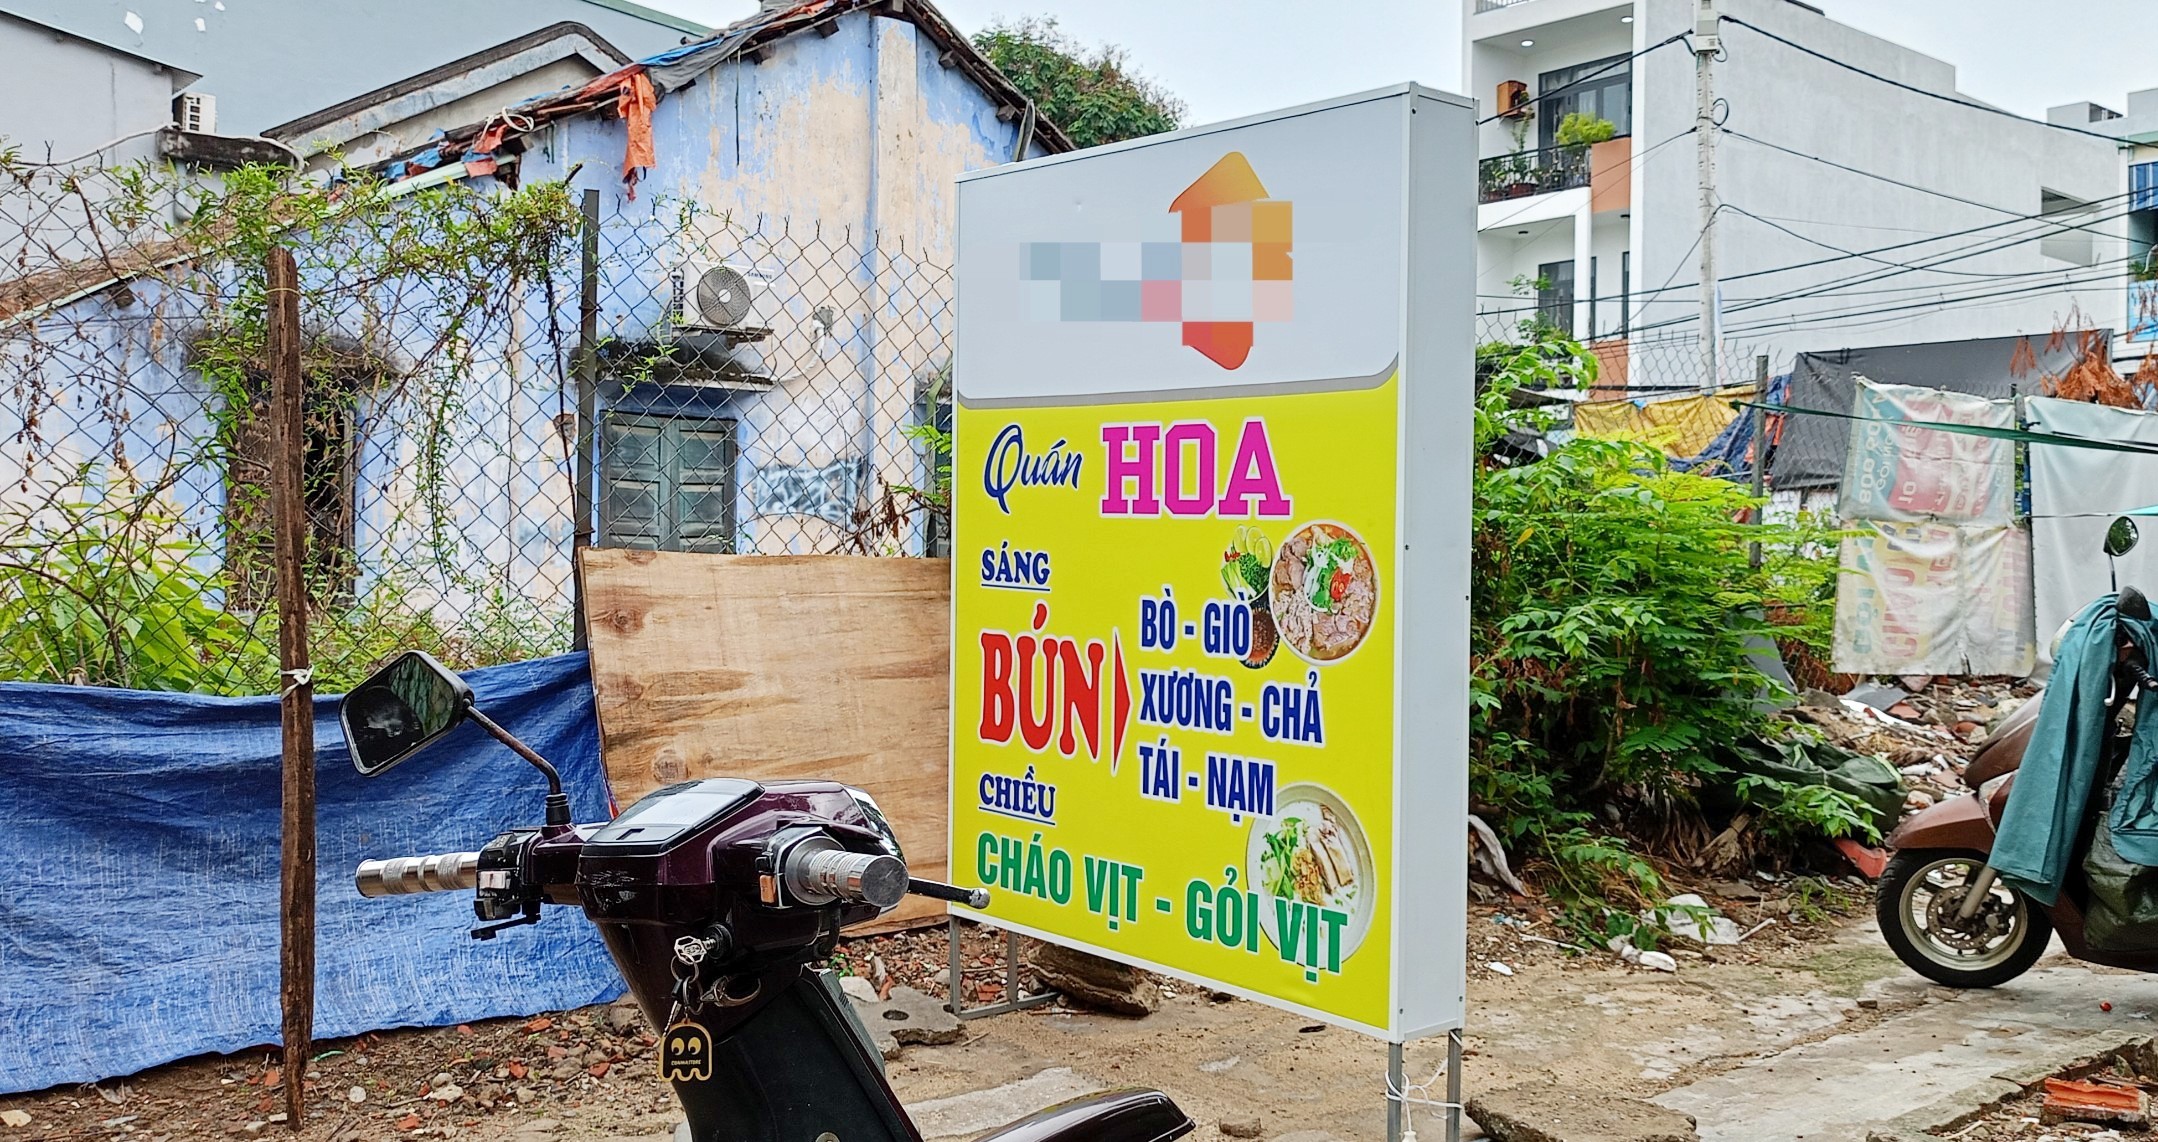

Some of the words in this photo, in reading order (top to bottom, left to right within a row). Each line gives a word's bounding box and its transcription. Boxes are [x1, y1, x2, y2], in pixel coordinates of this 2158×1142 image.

[983, 423, 1083, 515] Quán
[1100, 420, 1292, 517] HOA
[981, 540, 1051, 586] SÁNG
[1140, 588, 1176, 650] BÒ
[1204, 591, 1250, 657] GIÒ
[979, 602, 1105, 760] BÚN
[1140, 672, 1232, 731] XƯƠNG
[1262, 671, 1323, 744] CHẢ
[979, 765, 1056, 819] CHIỀU
[1139, 739, 1179, 800] TÁI
[1207, 756, 1275, 822] NẠM
[977, 832, 1071, 906] CHÁO
[1084, 856, 1143, 930] VỊT
[1186, 867, 1259, 953] GỎI
[1275, 898, 1348, 982] VỊT
